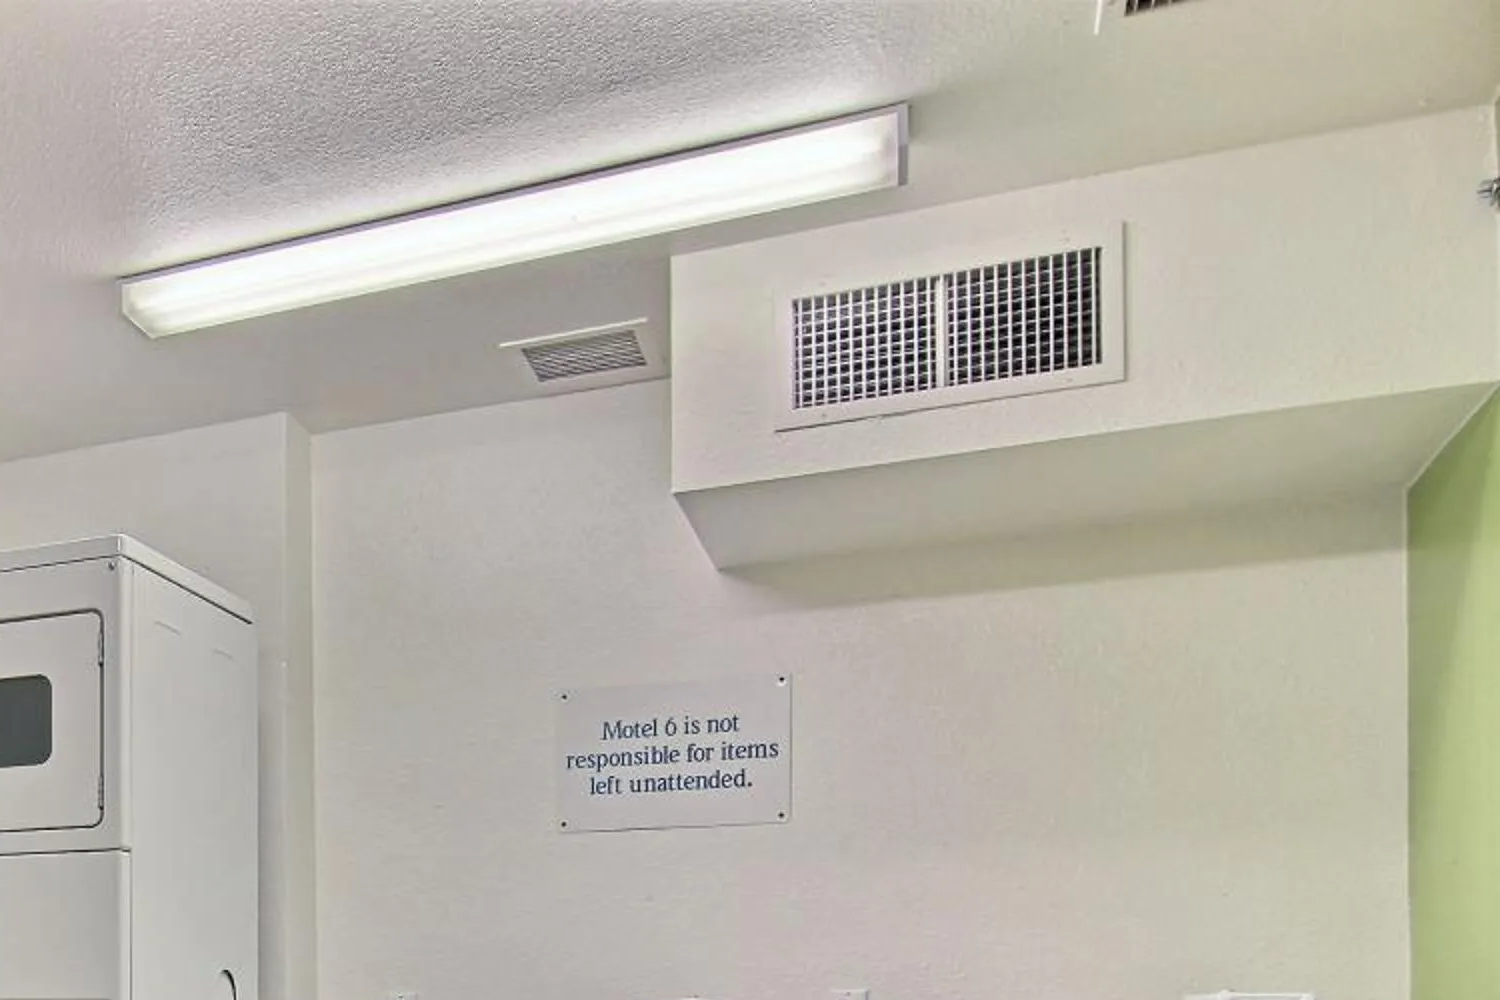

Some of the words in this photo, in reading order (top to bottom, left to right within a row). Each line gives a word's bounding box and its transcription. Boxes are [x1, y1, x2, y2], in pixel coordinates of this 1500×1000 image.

[600, 718, 658, 740] Motel
[664, 716, 678, 737] 6
[684, 715, 701, 735] is
[707, 713, 741, 733] not
[565, 745, 681, 772] responsible
[686, 742, 715, 764] for
[720, 740, 780, 761] items
[589, 775, 623, 795] left
[629, 768, 754, 793] unattended.
